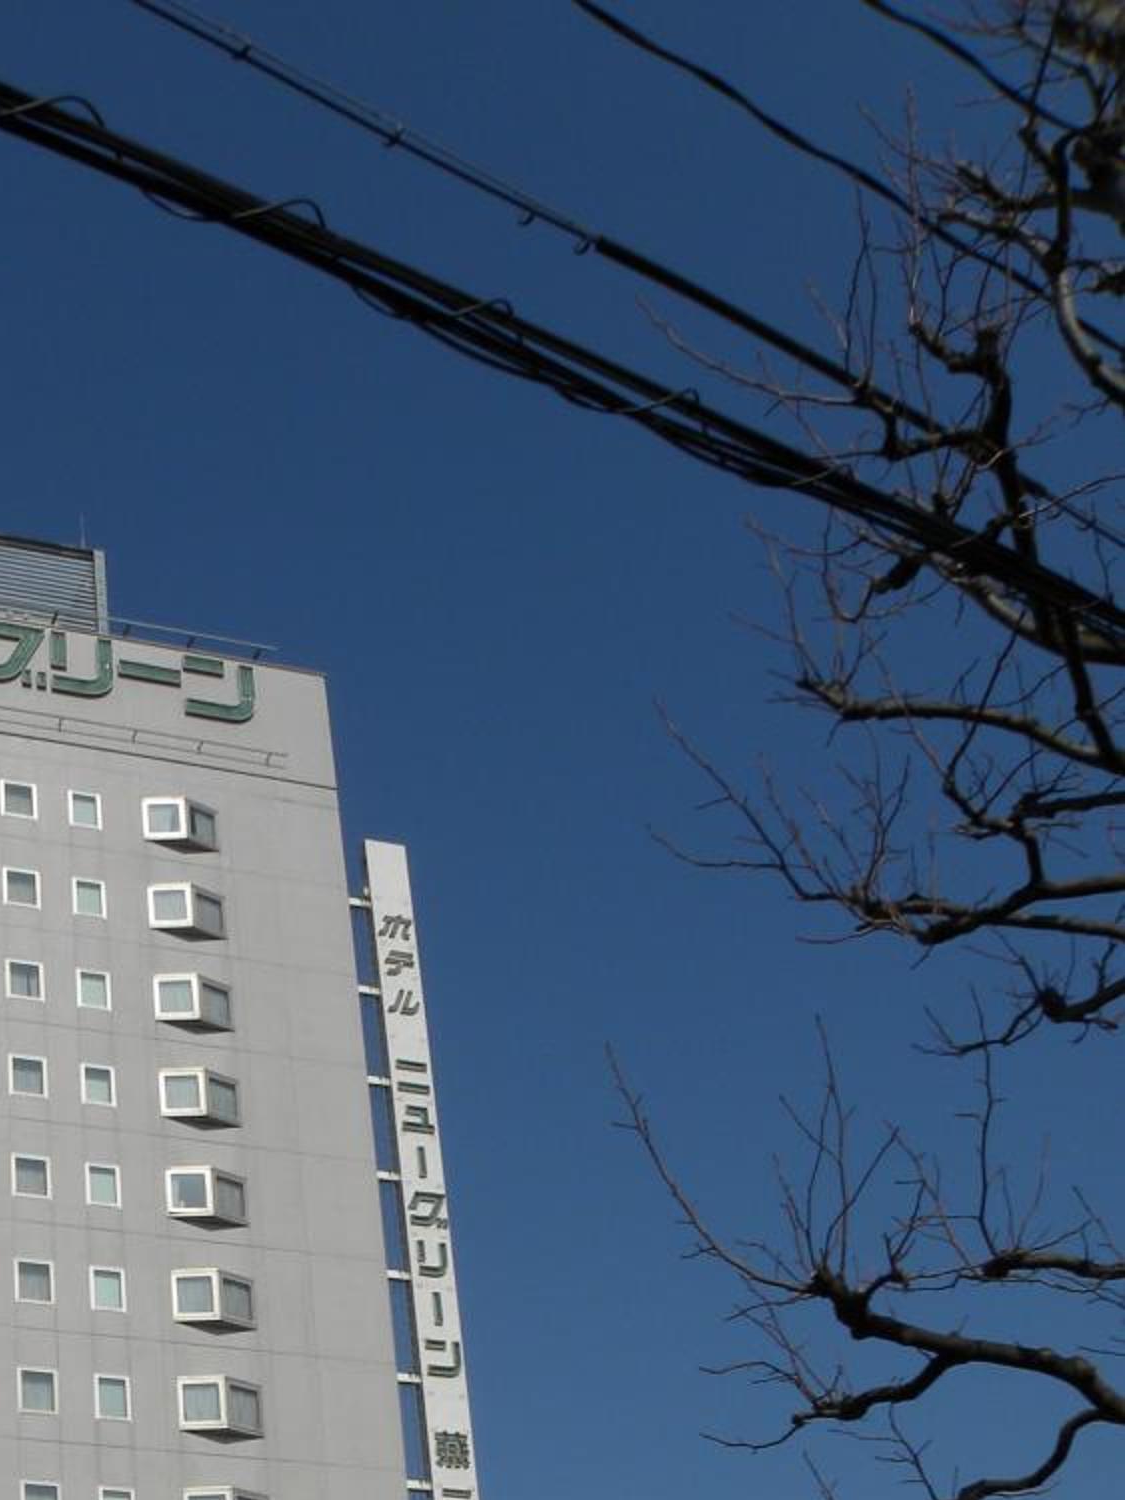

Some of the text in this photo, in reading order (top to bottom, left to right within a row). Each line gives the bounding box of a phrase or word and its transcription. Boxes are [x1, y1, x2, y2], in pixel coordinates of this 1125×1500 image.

[378, 914, 420, 1017] ホテル
[394, 1058, 462, 1378] ニューグリーン
